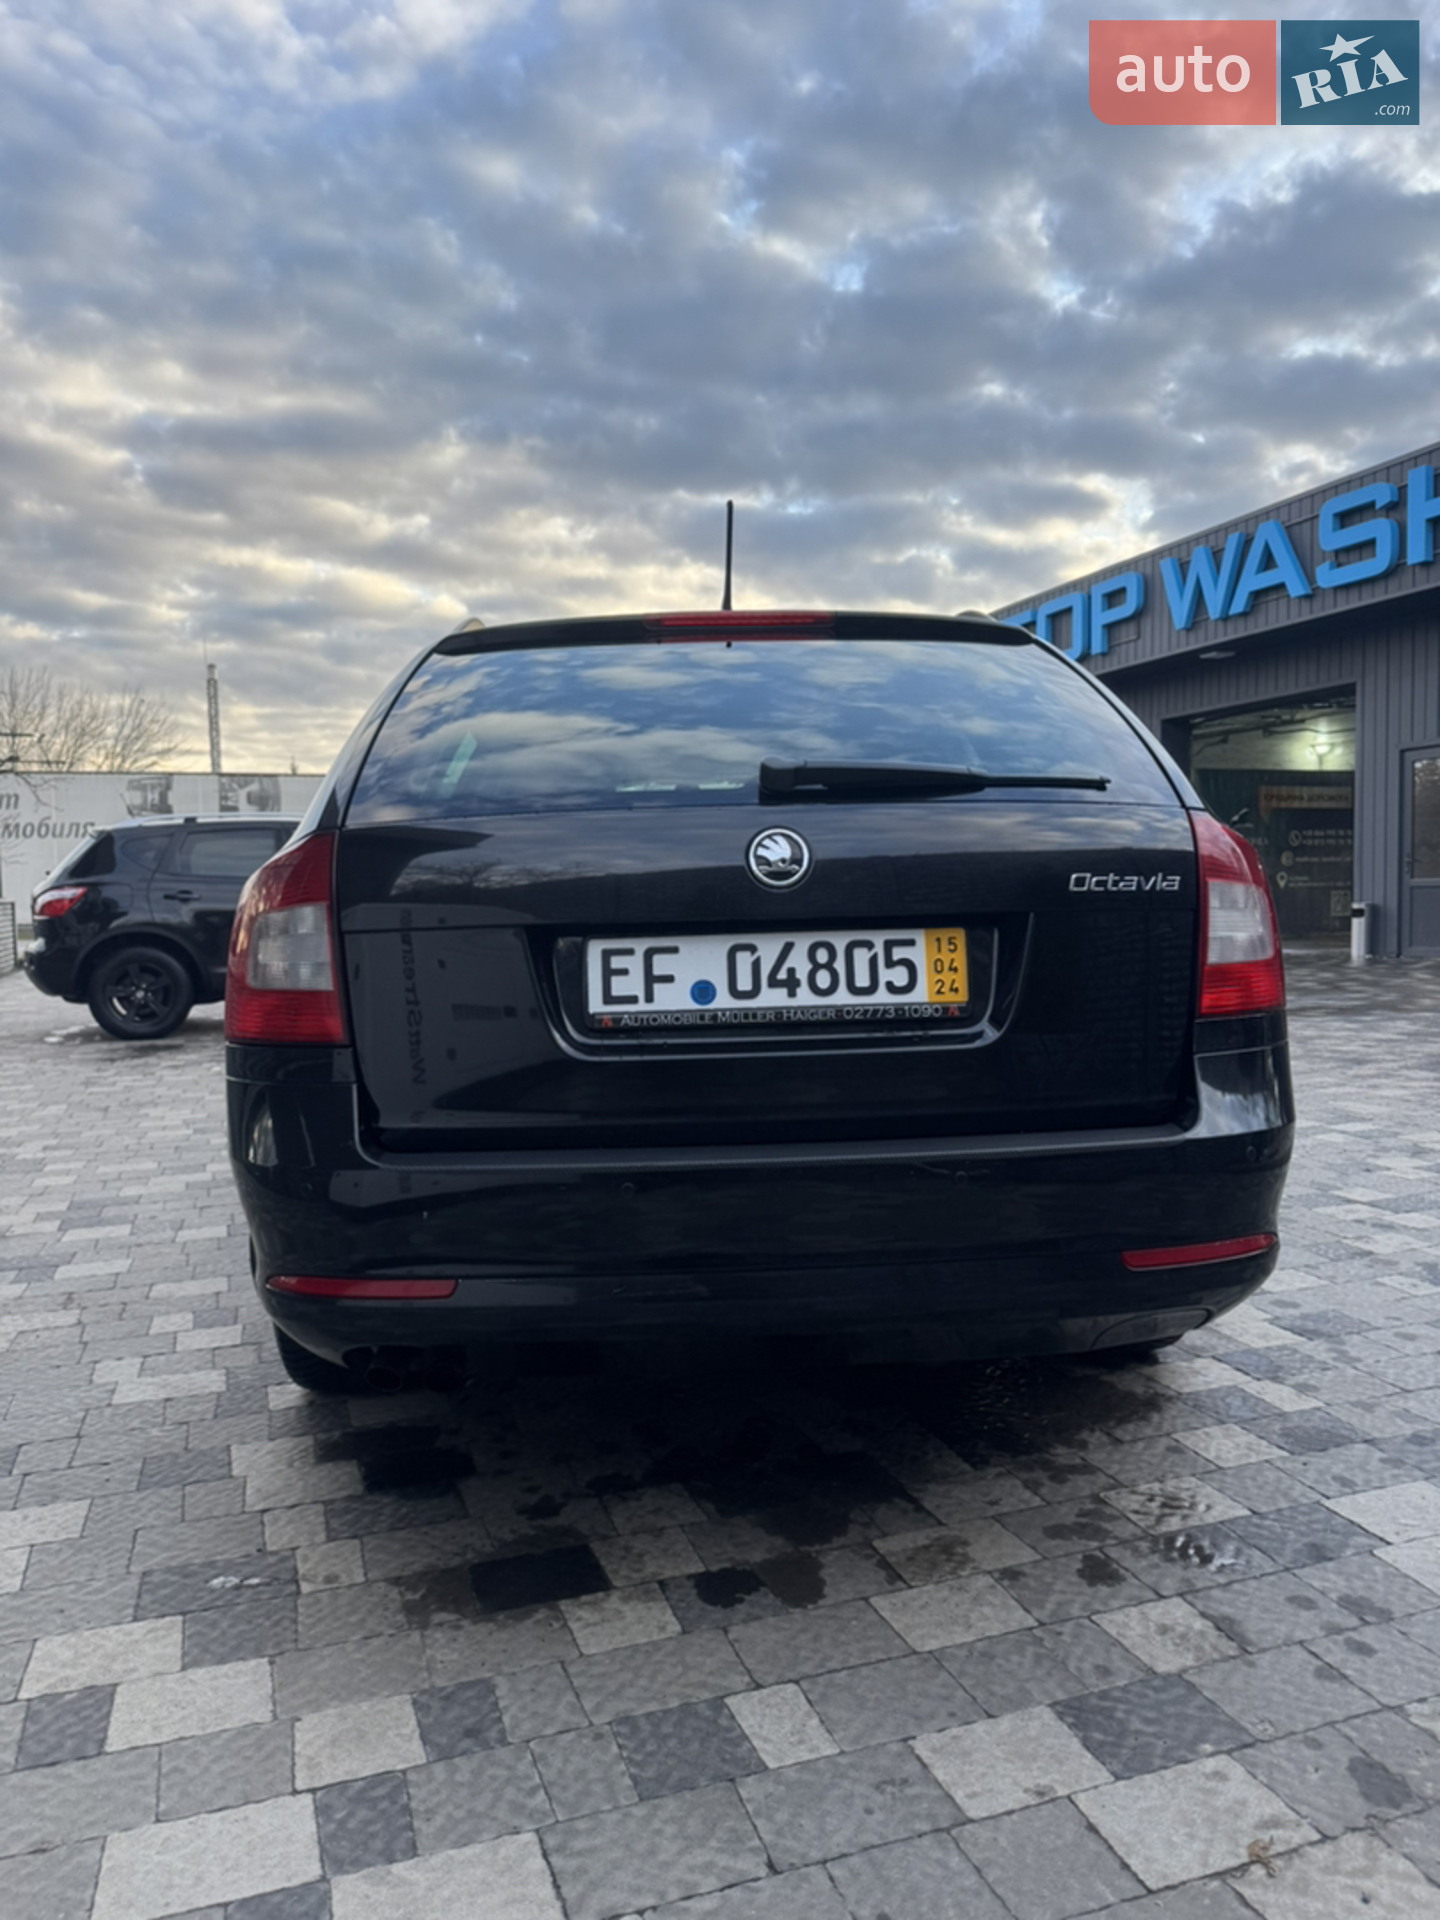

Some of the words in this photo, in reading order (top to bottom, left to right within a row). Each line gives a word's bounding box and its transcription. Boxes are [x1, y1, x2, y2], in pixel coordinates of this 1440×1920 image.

[1068, 872, 1181, 892] Octavia
[934, 936, 959, 954] 15
[601, 945, 680, 1006] EF
[727, 938, 918, 1001] 04805
[933, 957, 960, 975] 04
[934, 978, 960, 996] 24
[620, 1012, 714, 1027] AUTOMOBILE
